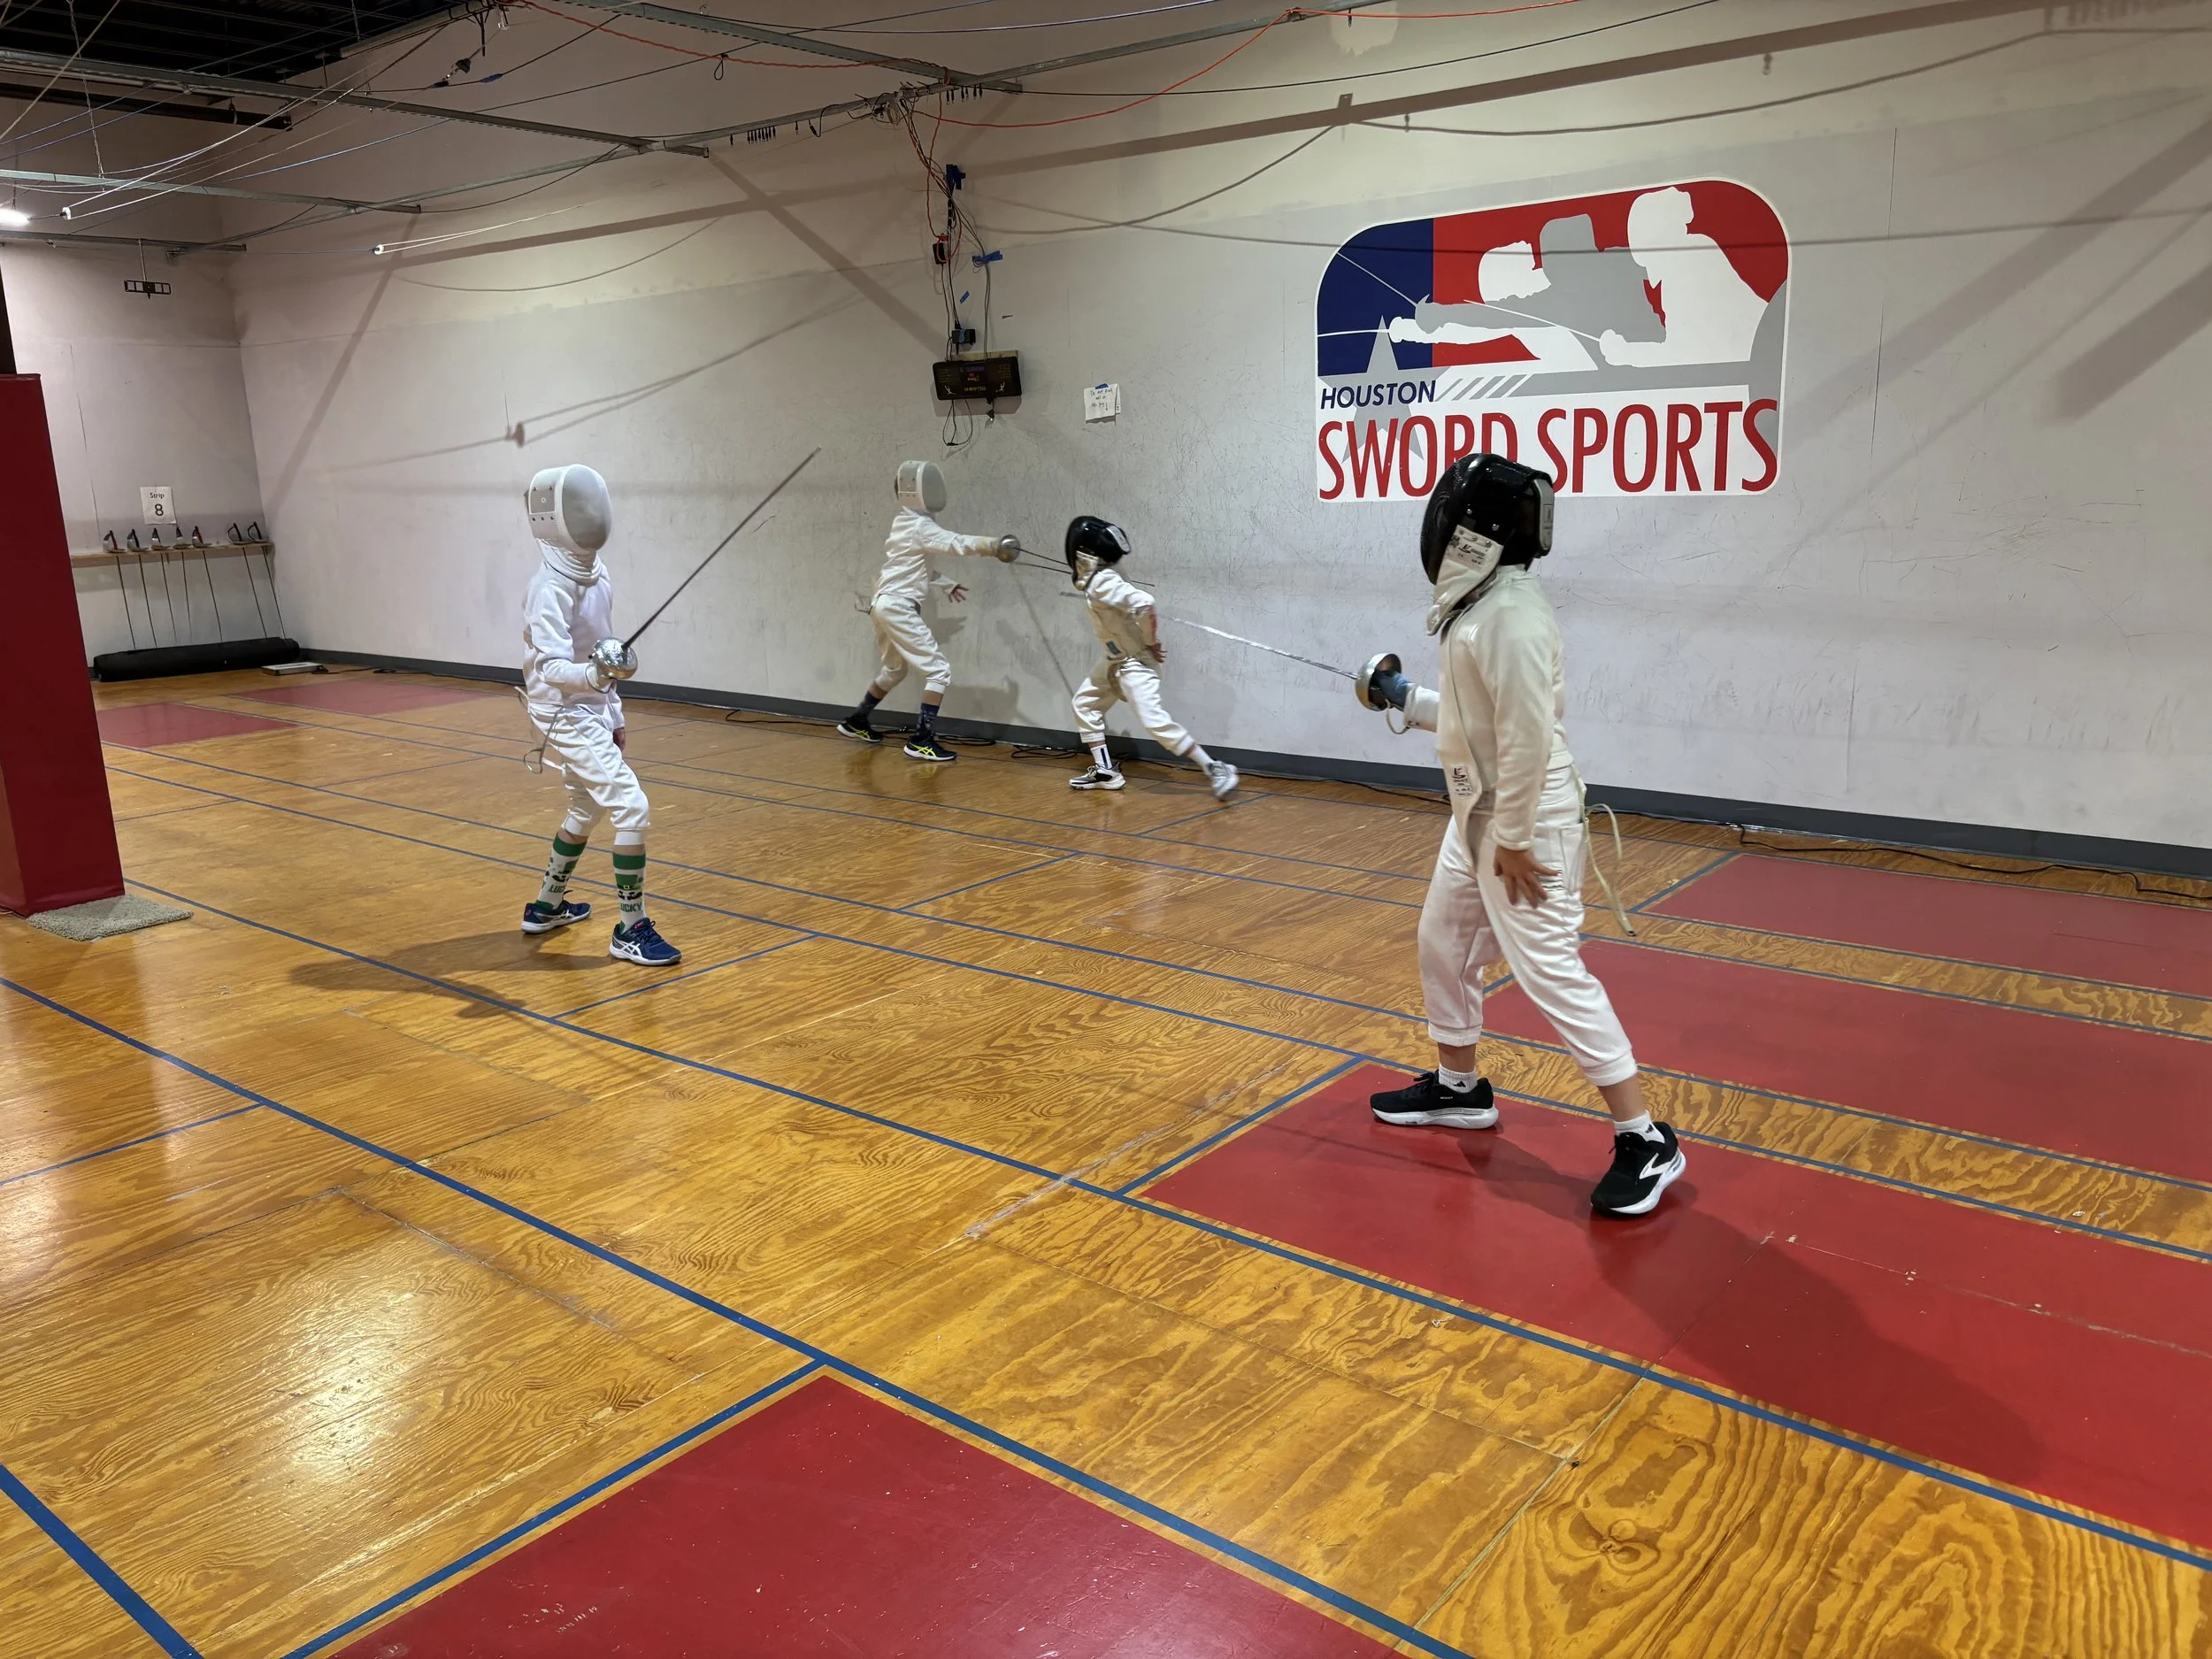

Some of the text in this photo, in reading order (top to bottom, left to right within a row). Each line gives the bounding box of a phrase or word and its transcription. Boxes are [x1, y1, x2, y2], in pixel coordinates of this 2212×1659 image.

[1321, 380, 1437, 410] HOUSTON
[1537, 399, 1778, 494] SPORTS
[154, 503, 165, 517] 8
[620, 902, 642, 913] UCKY
